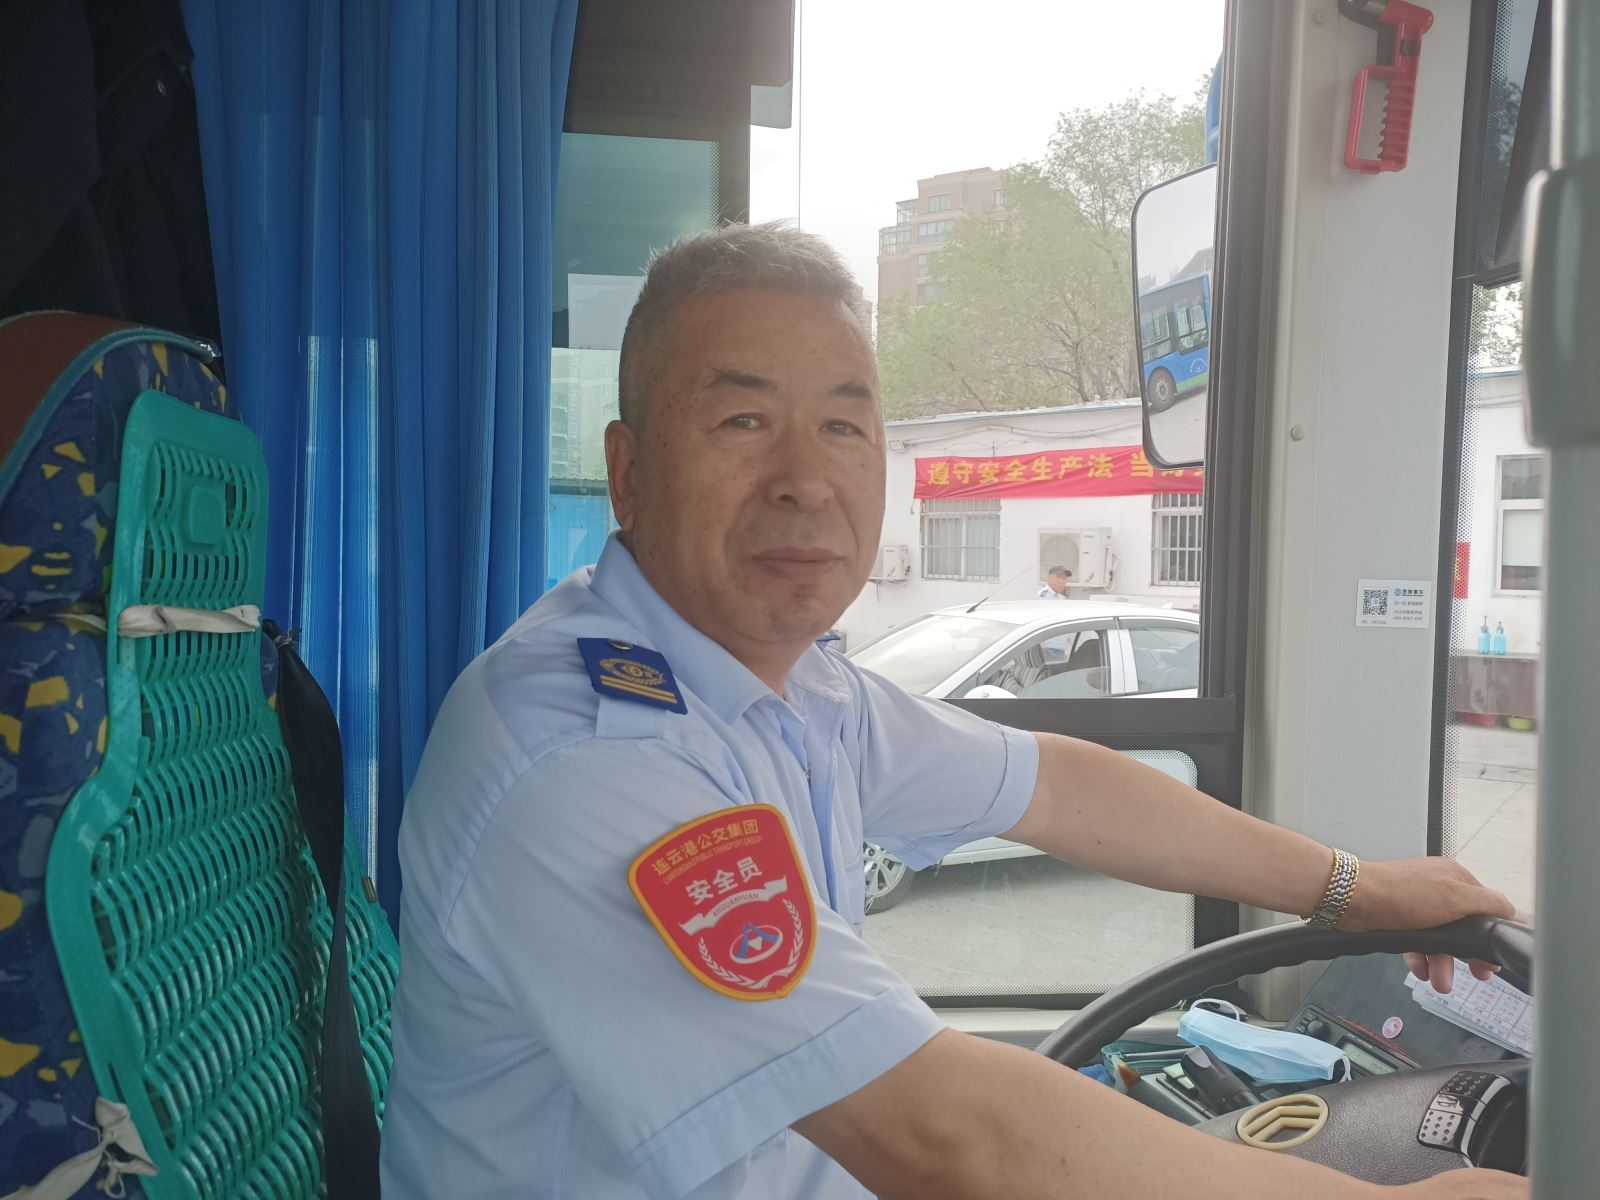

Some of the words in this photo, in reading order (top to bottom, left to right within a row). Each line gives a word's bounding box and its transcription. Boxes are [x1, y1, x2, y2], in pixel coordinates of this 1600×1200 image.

[928, 454, 1113, 485] 遵守安全生产法
[653, 819, 759, 875] 连云港公交集团
[686, 856, 762, 905] 安全员
